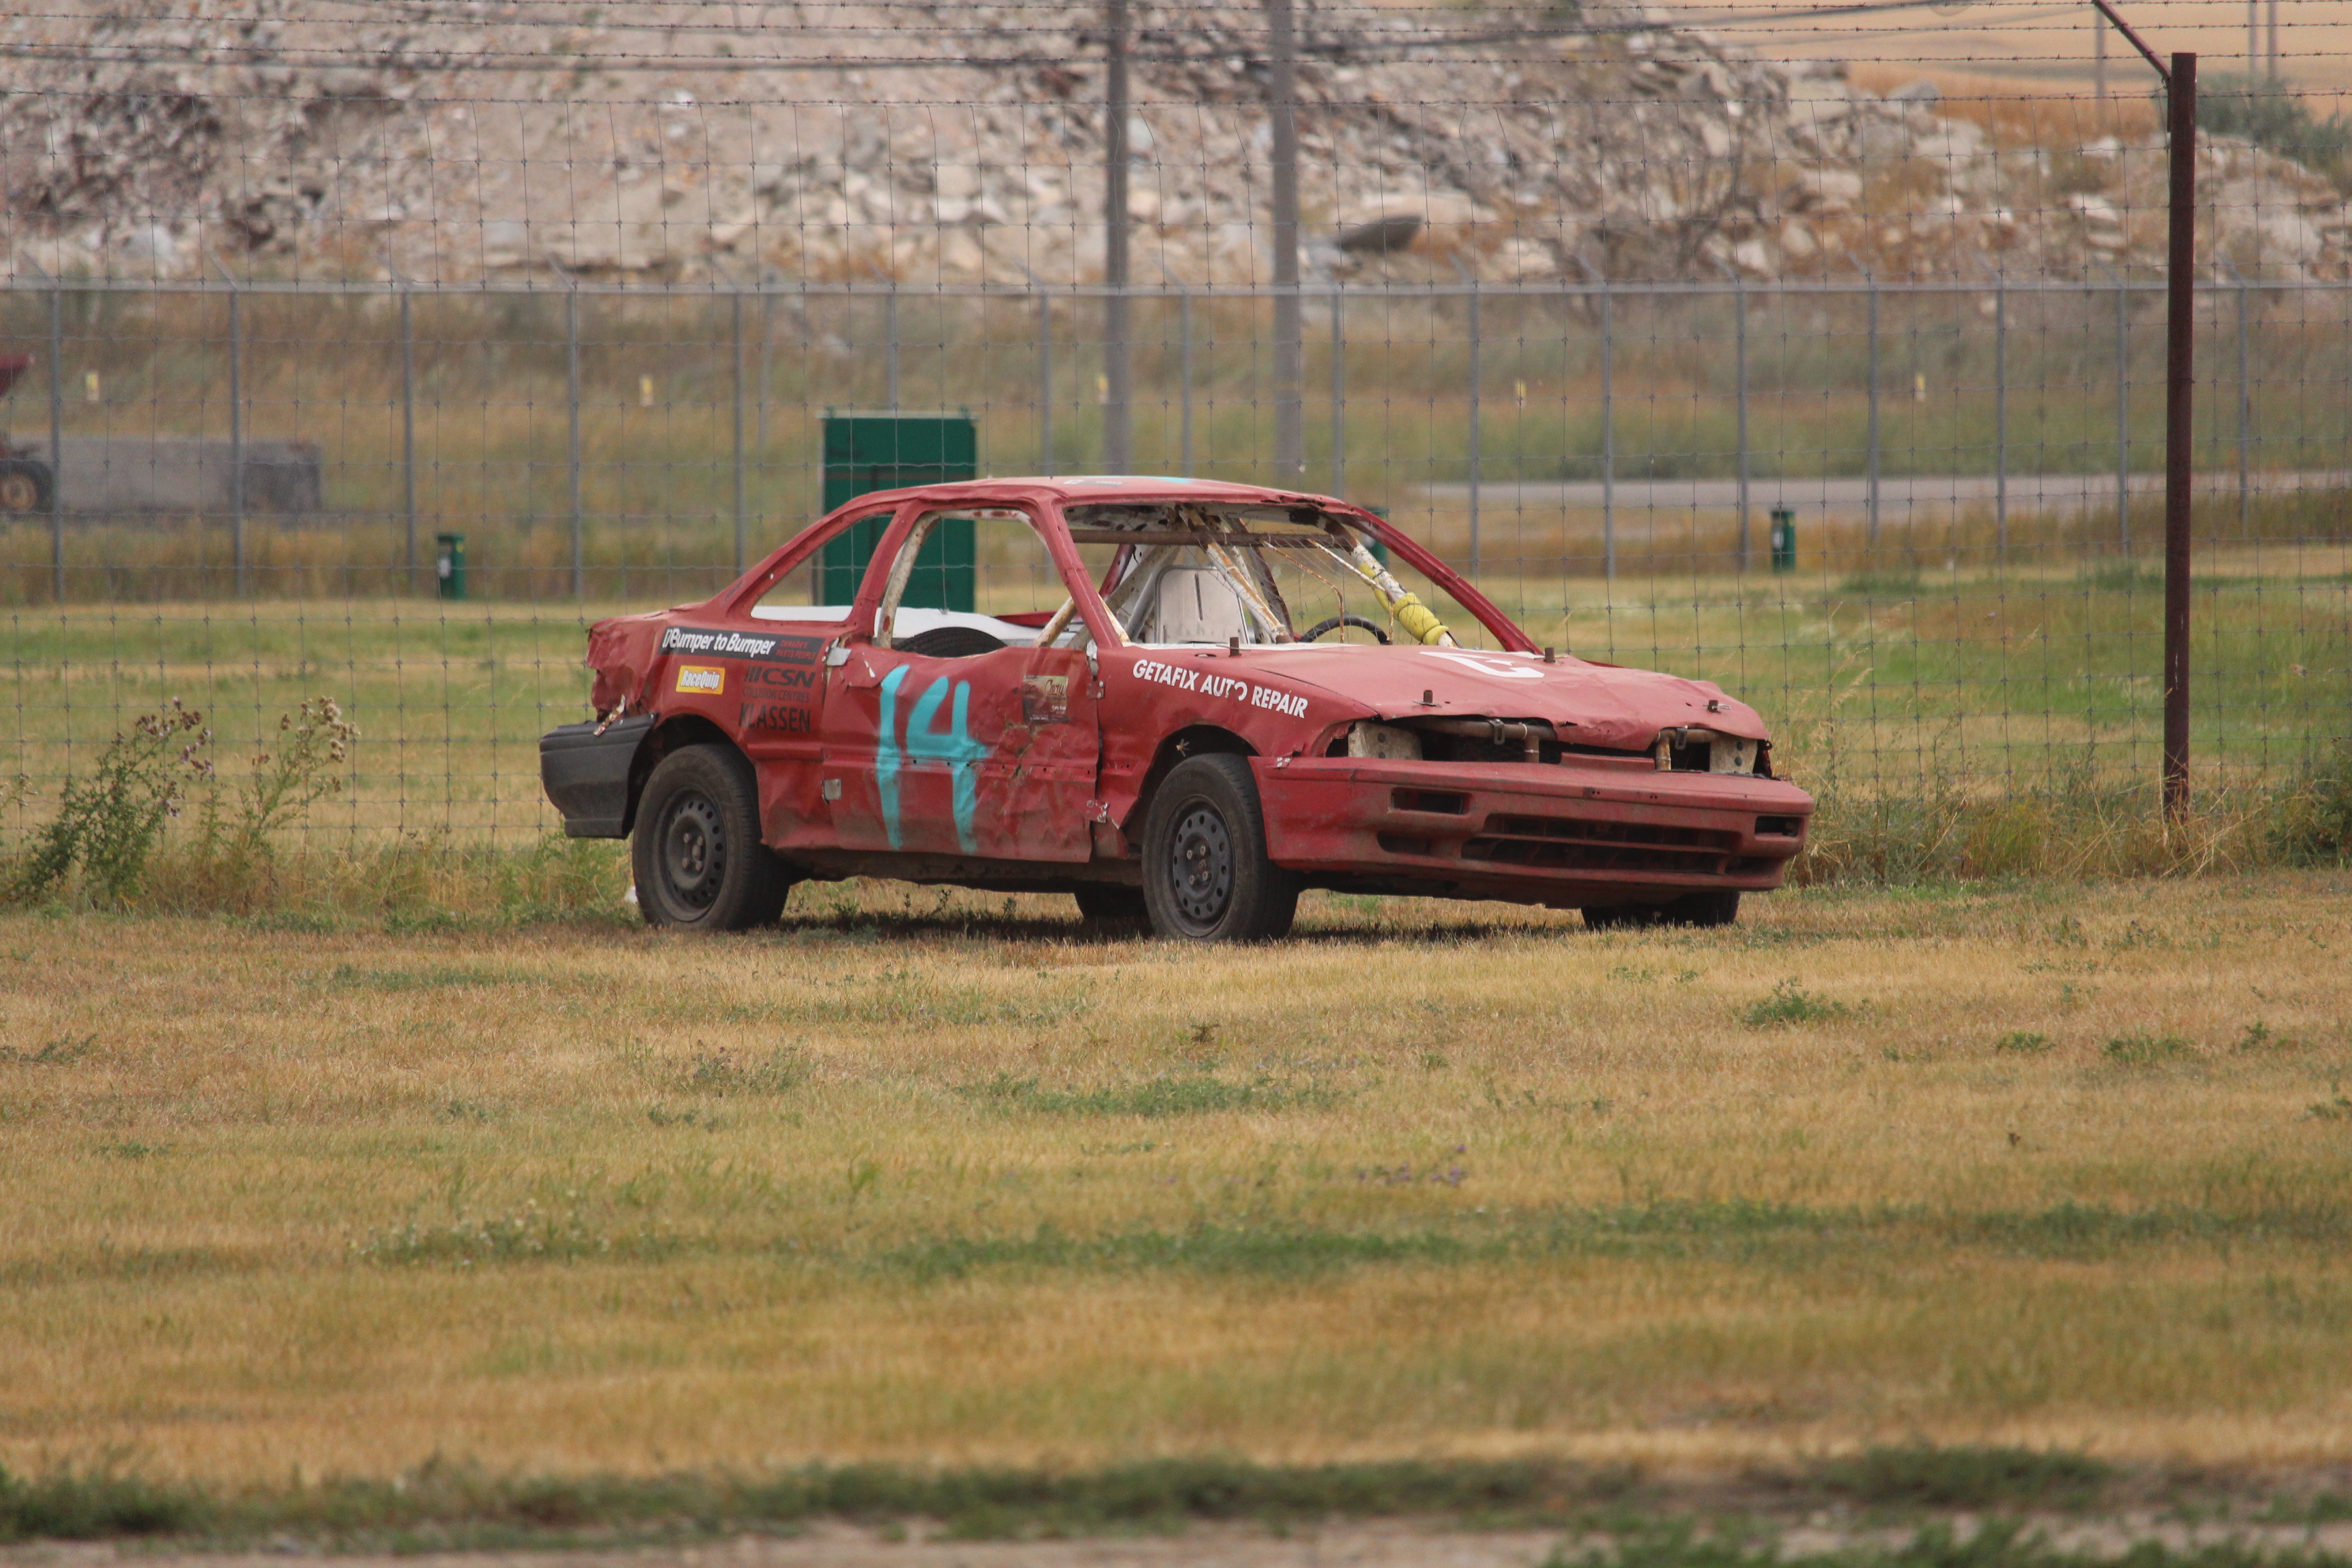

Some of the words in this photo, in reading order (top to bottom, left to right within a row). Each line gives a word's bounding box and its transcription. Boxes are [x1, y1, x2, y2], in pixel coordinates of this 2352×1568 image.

[713, 633, 728, 651] to
[725, 632, 776, 658] Bumper
[681, 670, 720, 690] RaceQuip
[762, 668, 816, 688] CSN
[1132, 659, 1200, 691] GETAFIX
[1252, 685, 1309, 719] REPAIR
[738, 702, 811, 732] KLASSEN
[876, 664, 991, 856] 14
